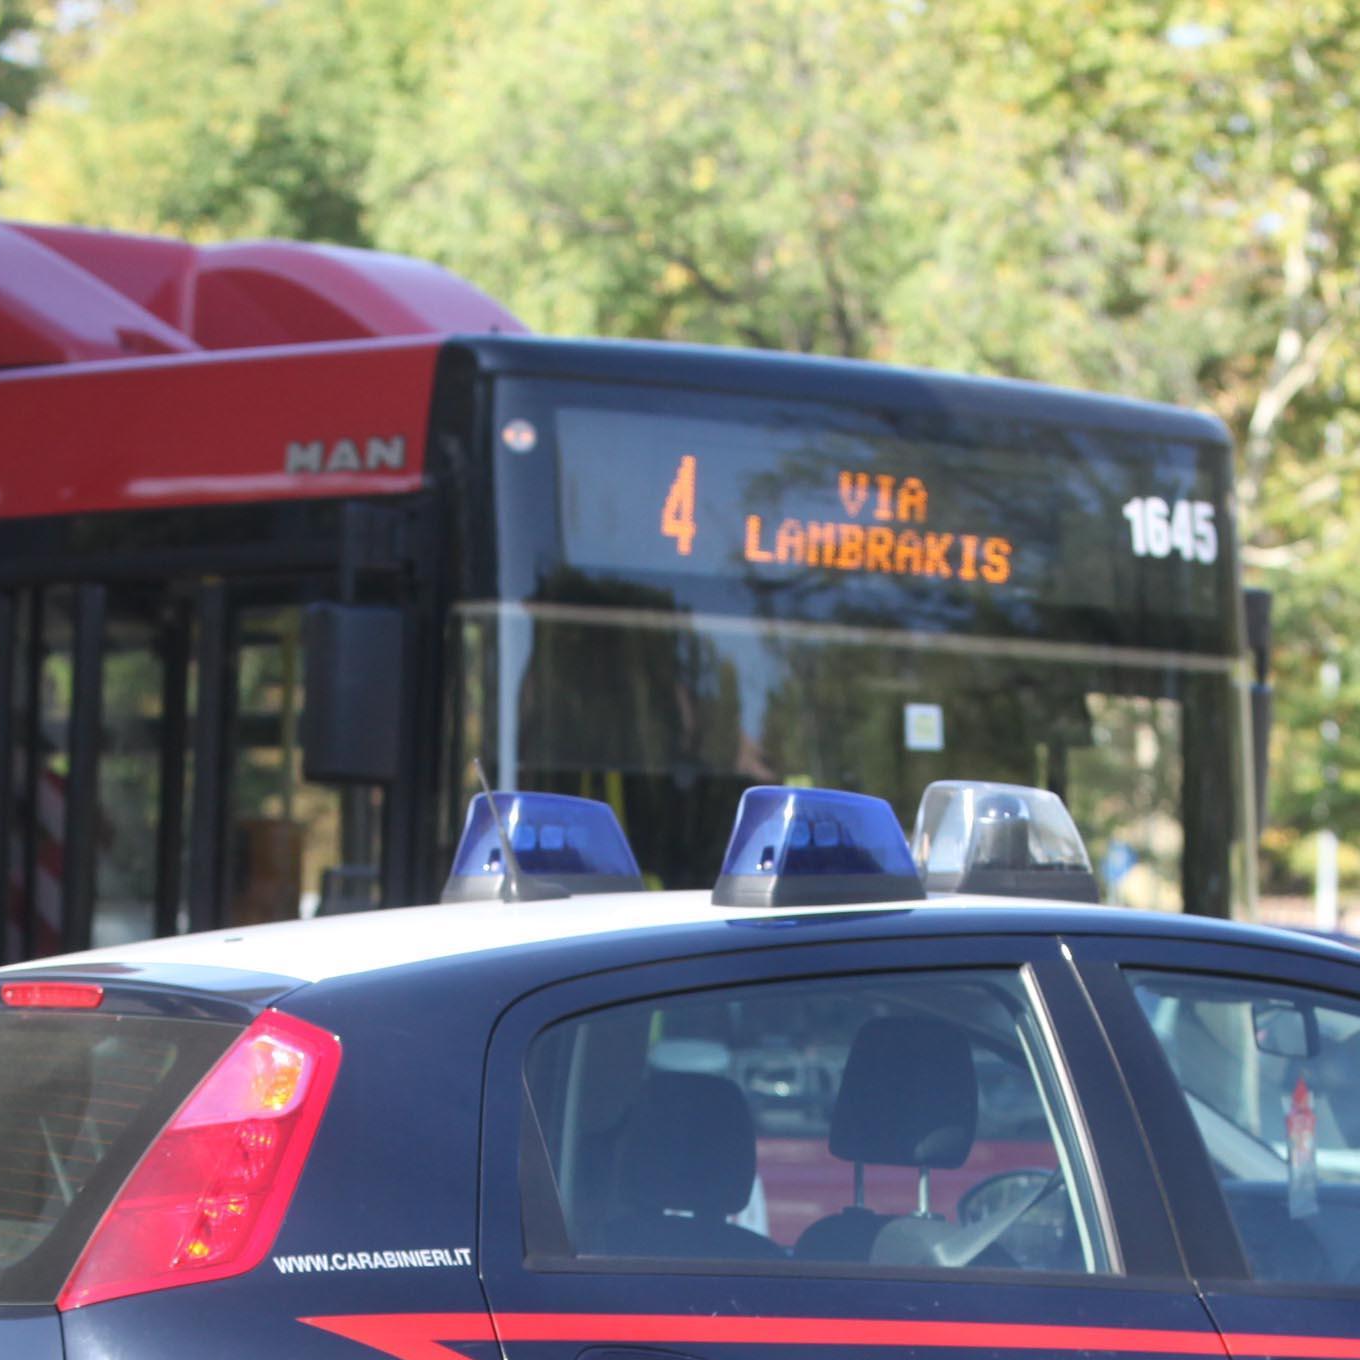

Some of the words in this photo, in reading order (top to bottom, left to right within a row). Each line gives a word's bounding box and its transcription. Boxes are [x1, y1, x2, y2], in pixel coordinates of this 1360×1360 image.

[286, 435, 406, 475] MAN
[661, 455, 697, 555] 4
[839, 470, 928, 523] VIA
[745, 514, 1013, 584] LAMBRAKIS
[1122, 496, 1218, 565] 1645
[273, 1248, 472, 1274] WWW.CARABINIERI.IT
